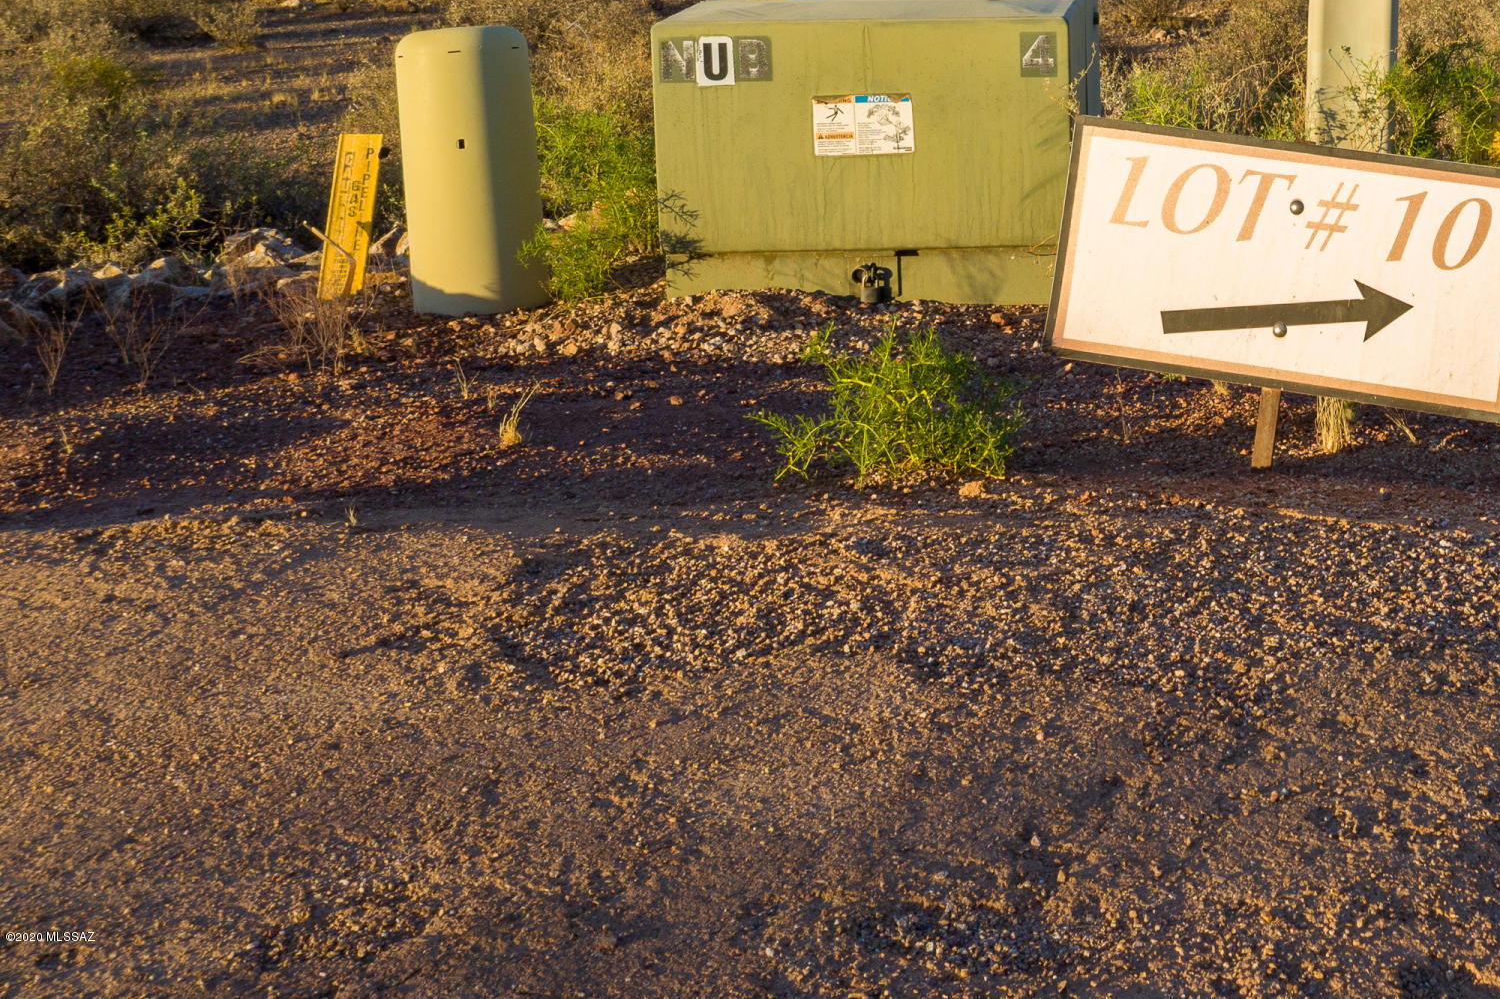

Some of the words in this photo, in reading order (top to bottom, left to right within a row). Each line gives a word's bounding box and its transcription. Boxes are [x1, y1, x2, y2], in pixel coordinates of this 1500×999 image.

[1022, 34, 1054, 72] 4
[347, 180, 362, 218] GAS
[1109, 155, 1297, 242] LOT
[1304, 182, 1360, 252] #
[1385, 191, 1493, 271] 10
